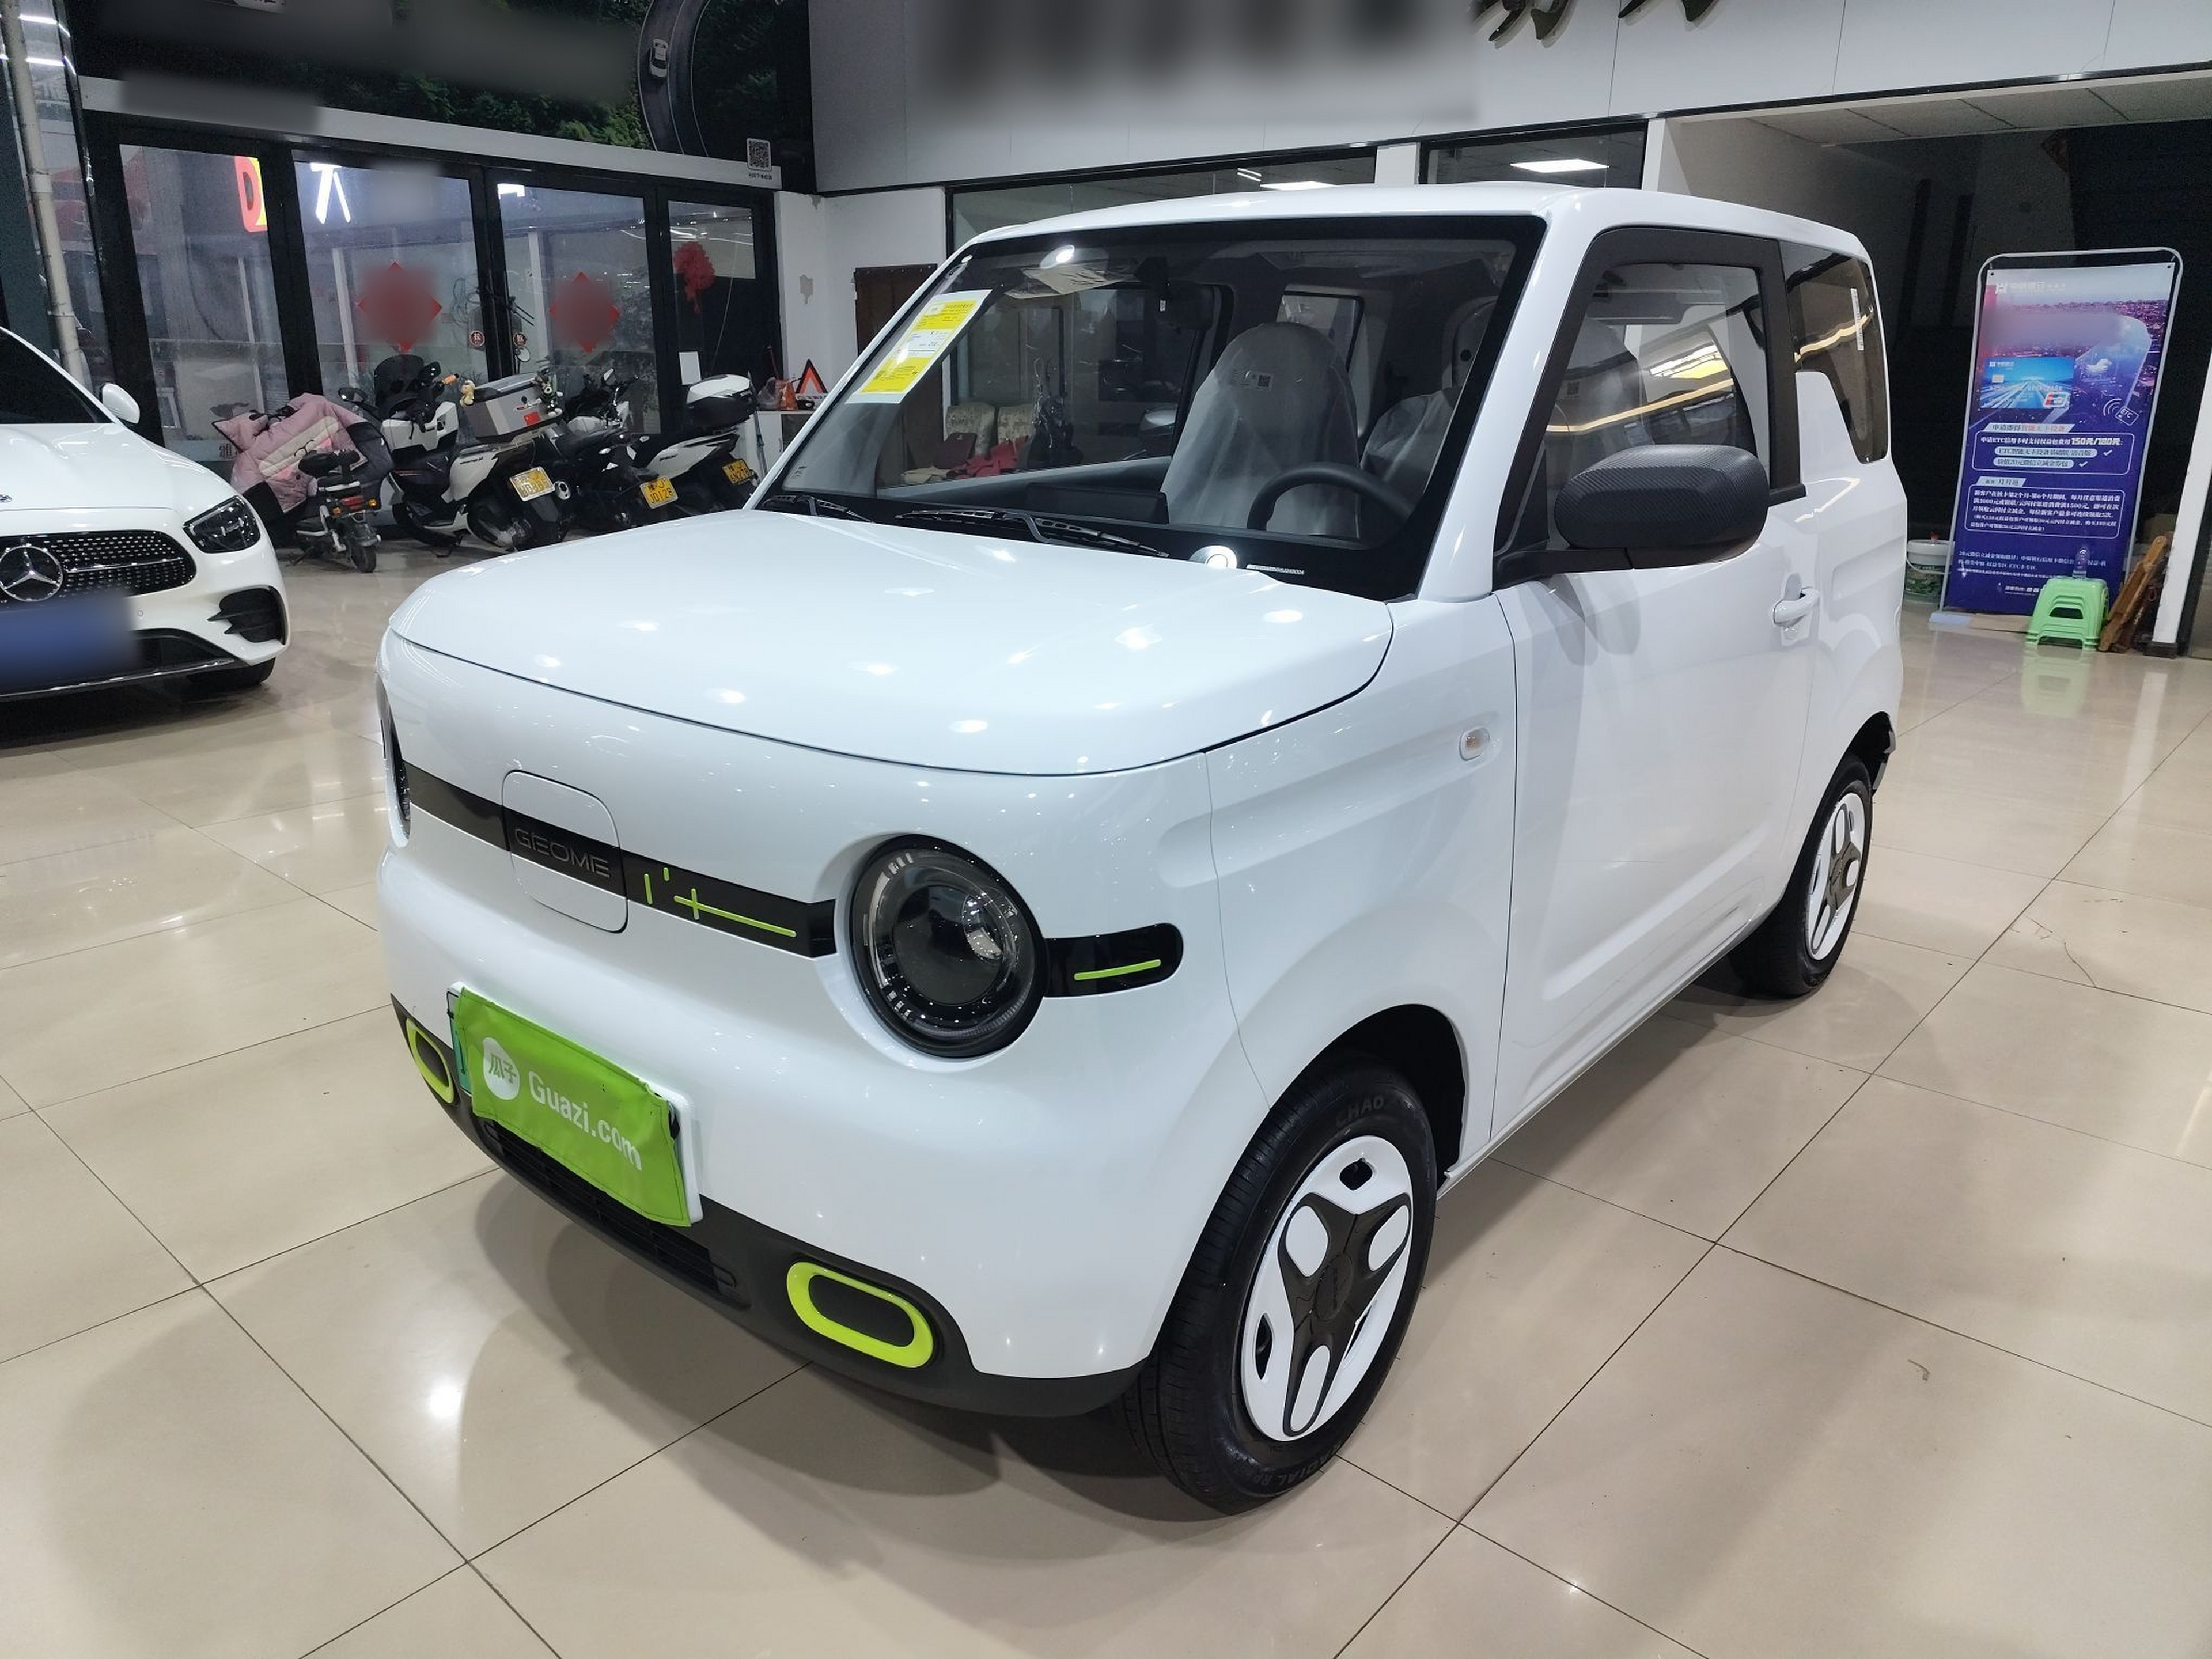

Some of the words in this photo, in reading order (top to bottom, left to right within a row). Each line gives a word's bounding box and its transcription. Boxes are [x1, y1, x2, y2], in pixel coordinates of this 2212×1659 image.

[2120, 407, 2134, 419] ETC
[650, 487, 673, 503] JD128
[514, 828, 610, 878] GEOME
[488, 1054, 517, 1084] 瓜子
[528, 1071, 643, 1171] Guazi.com
